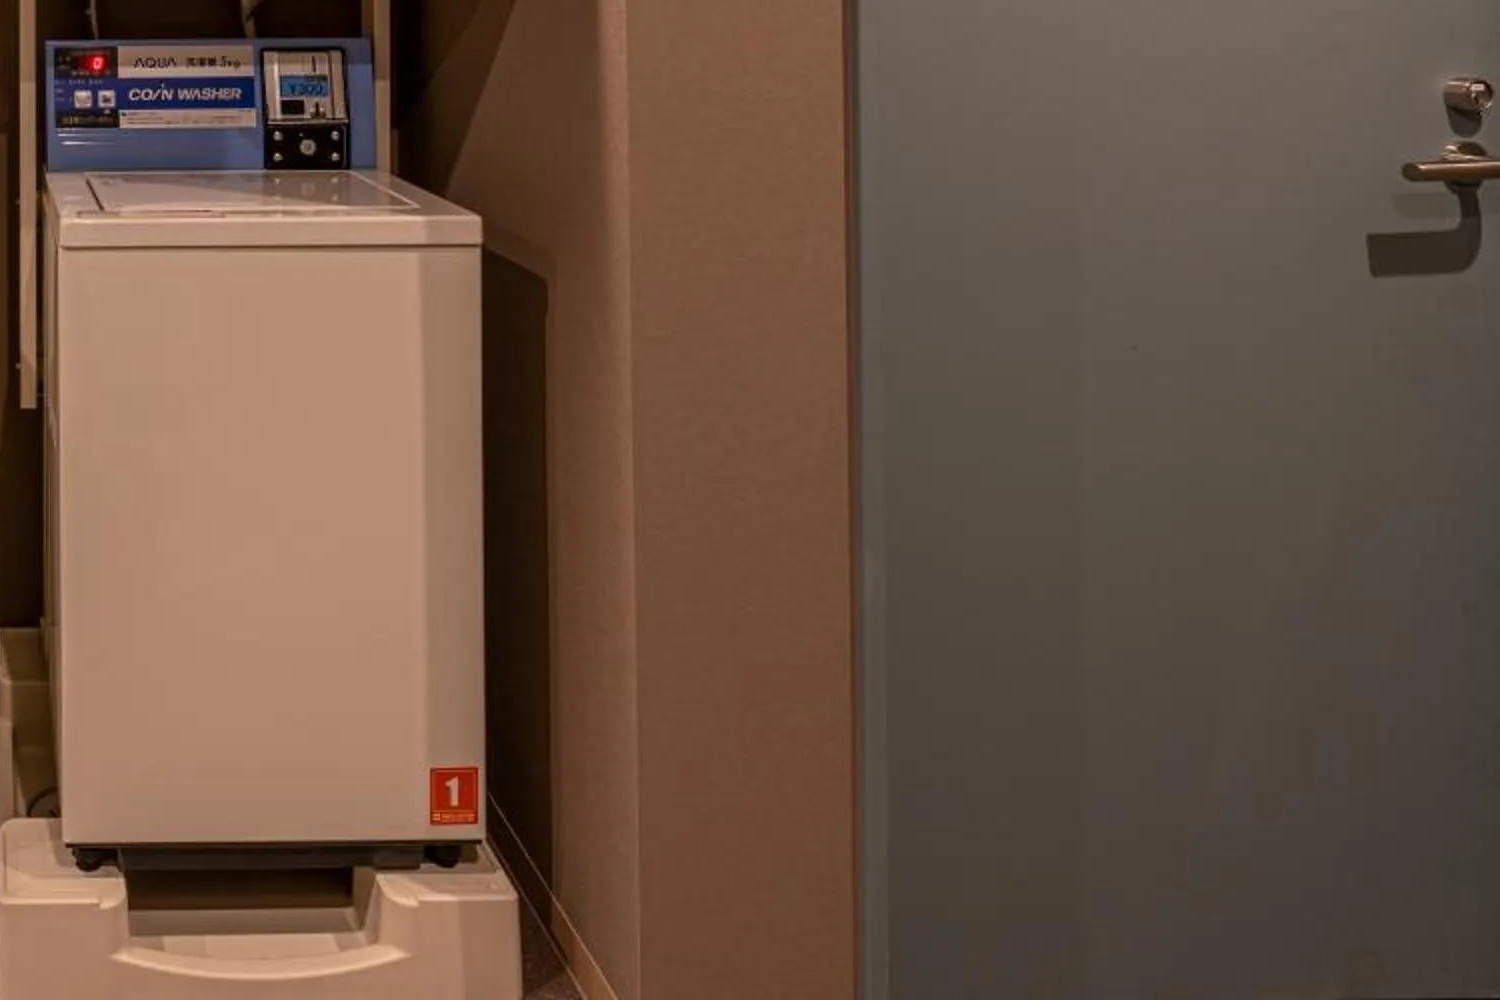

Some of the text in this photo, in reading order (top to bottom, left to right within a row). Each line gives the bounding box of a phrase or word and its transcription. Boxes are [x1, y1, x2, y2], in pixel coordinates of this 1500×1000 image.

[93, 56, 104, 69] 0
[133, 56, 177, 69] AQUA
[177, 87, 242, 100] WASHER
[445, 775, 459, 807] 1
